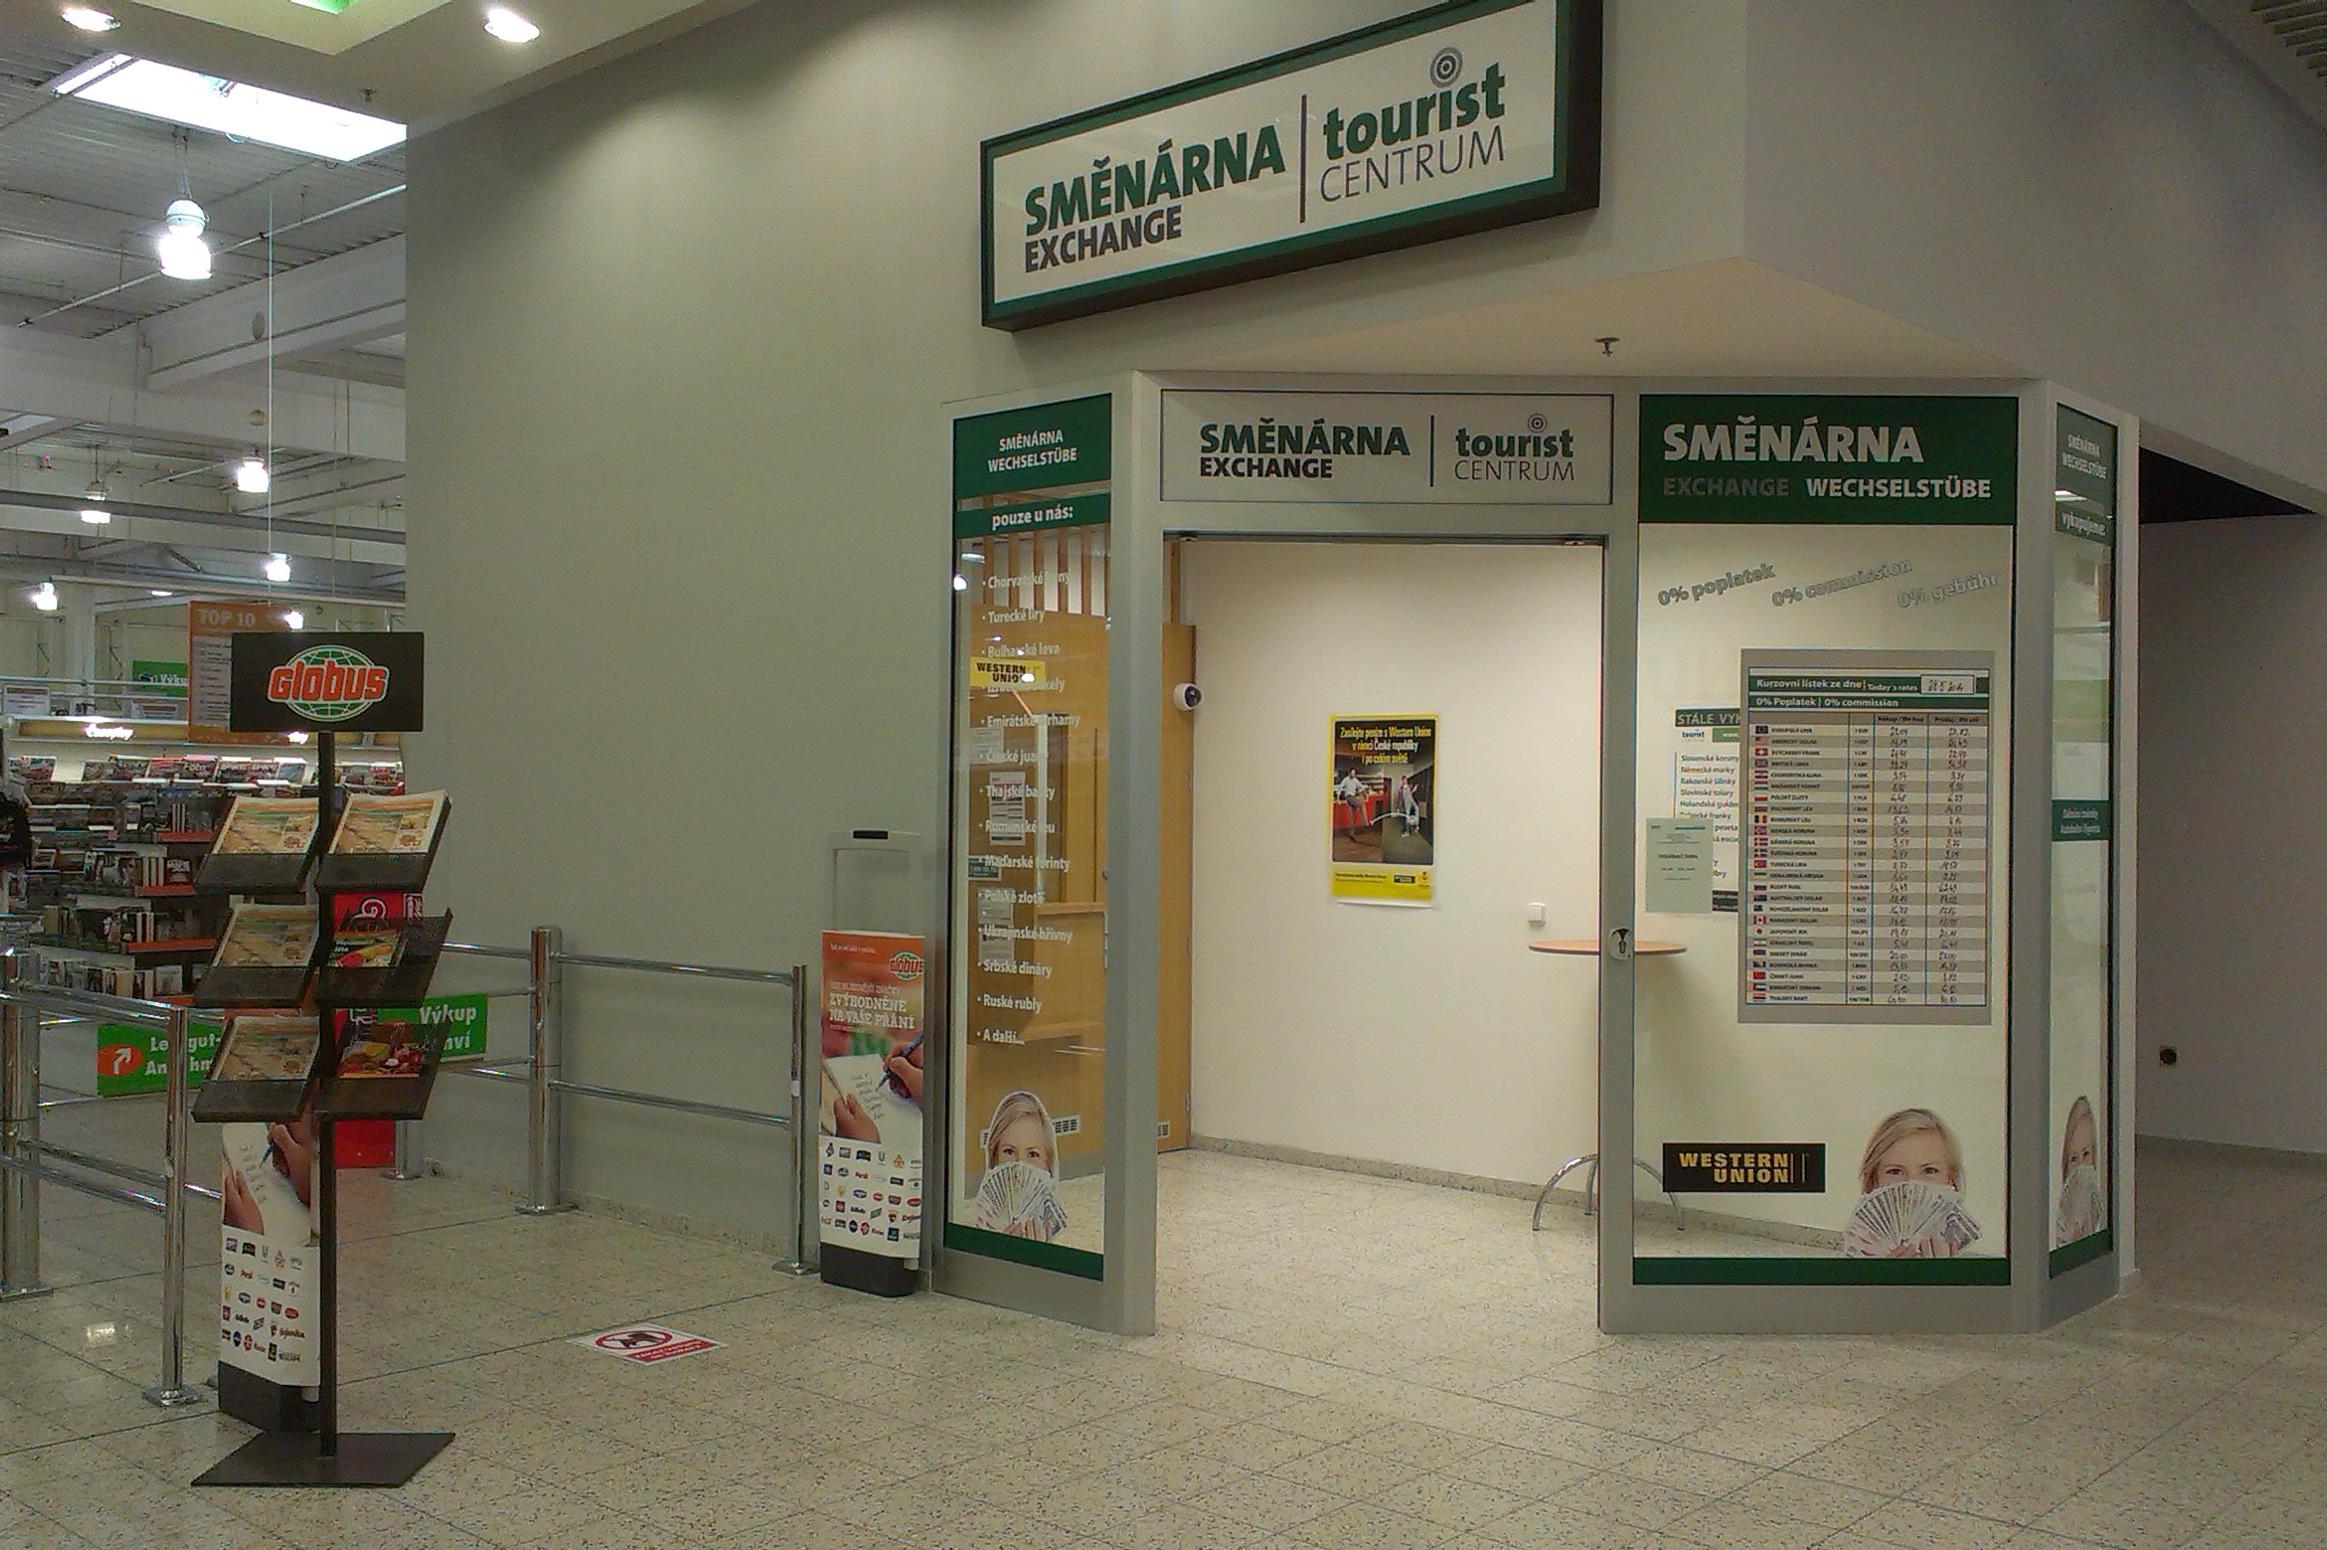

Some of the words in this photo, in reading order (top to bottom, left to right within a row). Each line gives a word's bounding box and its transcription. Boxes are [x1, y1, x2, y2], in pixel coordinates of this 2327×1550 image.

[1323, 62, 1506, 161] tourist
[1320, 126, 1505, 203] CENTRUM
[1024, 124, 1286, 236] SMĚNÁRNA
[1024, 204, 1182, 272] EXCHANGE
[999, 429, 1064, 452] SMĚNÁRNA
[1199, 417, 1411, 456] SMĚNÁRNA
[1455, 427, 1574, 459] tourist
[1663, 415, 1924, 464] SMĚNÁRNA
[987, 447, 1078, 473] WECHSELSTÜBE
[1199, 457, 1333, 479] EXCHANGE
[1453, 460, 1575, 482] CENTRUM
[1663, 477, 1790, 497] EXCHANGE
[1806, 475, 1992, 499] WECHSELSTÜBE
[992, 511, 1032, 531] pouze
[1034, 512, 1043, 522] u
[1045, 504, 1074, 520] nás:
[1657, 586, 1690, 607] 0%
[1691, 562, 1777, 601] poplatek
[1771, 586, 1804, 608] 0%
[1805, 559, 1913, 599] commission
[1932, 571, 2000, 602] gebühr
[198, 608, 232, 625] TOP
[237, 612, 255, 628] 10
[988, 610, 1026, 624] Turecké
[976, 662, 1026, 674] WESTERN
[992, 673, 1026, 684] UNIO
[1756, 679, 1801, 689] Kurzovní
[1801, 679, 1829, 688] lístek
[1830, 680, 1841, 688] ze
[1898, 684, 1919, 692] rates
[1756, 698, 1772, 706] 0%
[1773, 698, 1817, 707] Poplatek
[1824, 698, 1841, 706] 0%
[1842, 699, 1899, 707] commission
[1678, 712, 1714, 725] STÁLE
[983, 960, 1018, 975] Srbské
[1019, 961, 1053, 979] dináry
[419, 1003, 477, 1026] Výkup
[983, 993, 1014, 1009] Ruské
[1015, 997, 1042, 1014] rubly
[149, 1033, 221, 1055] Legut-
[983, 1028, 991, 1041] A
[1679, 1152, 1789, 1169] WESTERN
[1713, 1168, 1789, 1183] UNION
